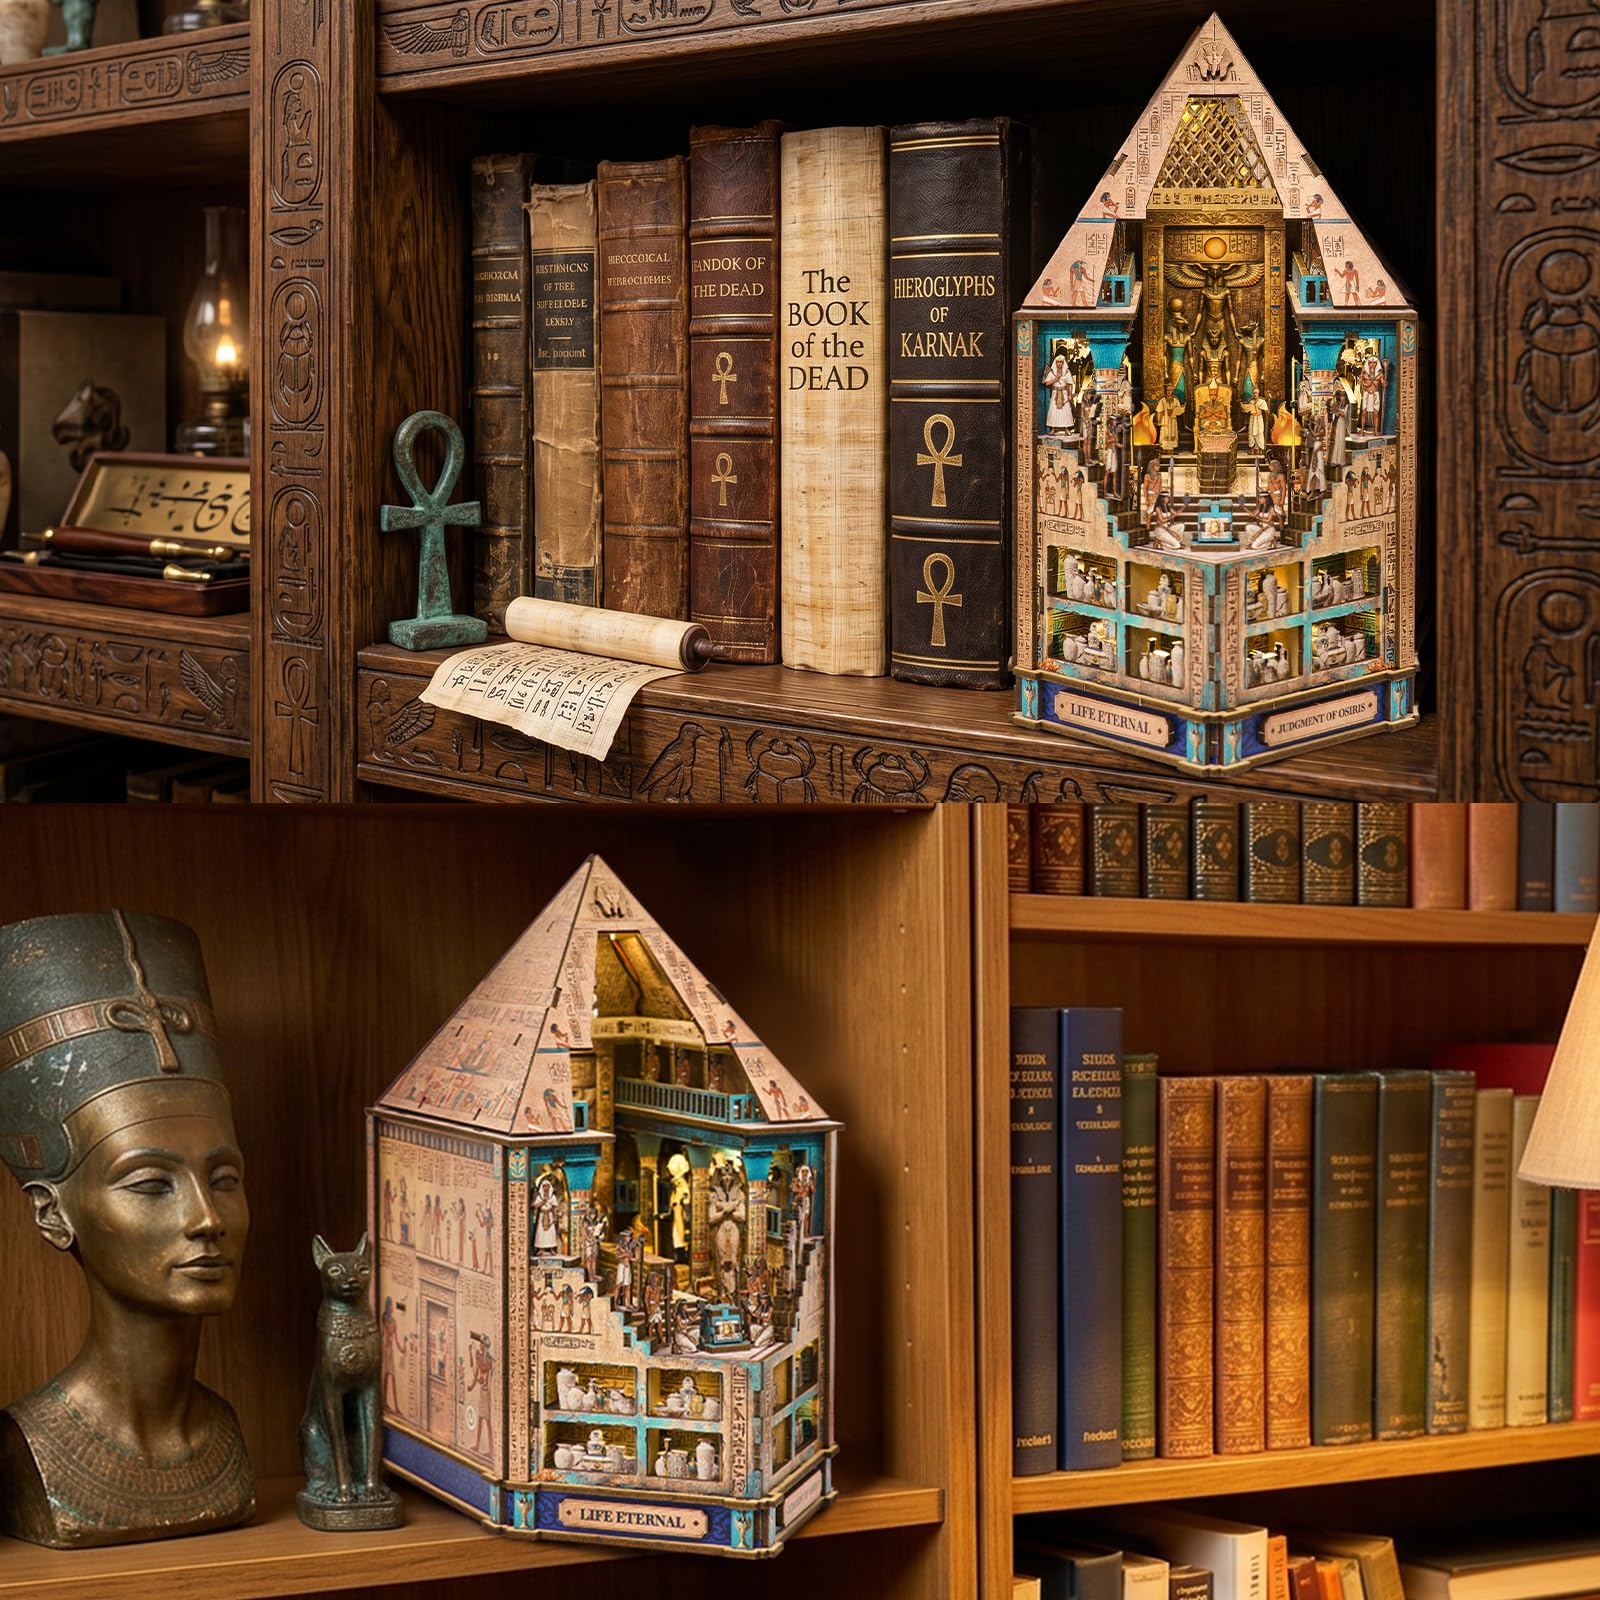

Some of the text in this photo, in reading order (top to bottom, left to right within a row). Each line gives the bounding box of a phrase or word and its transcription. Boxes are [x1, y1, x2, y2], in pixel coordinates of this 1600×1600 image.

[745, 257, 766, 270] OF
[693, 282, 764, 298] THE DEAD
[802, 268, 851, 294] The
[893, 275, 996, 299] HIEROGLYPHS
[788, 301, 871, 327] BOOK
[929, 306, 950, 323] OF
[791, 332, 865, 358] of the
[900, 331, 984, 358] KARNAK
[788, 365, 869, 391] DEAD
[1070, 702, 1152, 735] LIFE ETERNAL
[1277, 702, 1366, 734] JUDGMENT OF OSIRIS
[579, 1508, 686, 1529] LIFE ETERNAL
